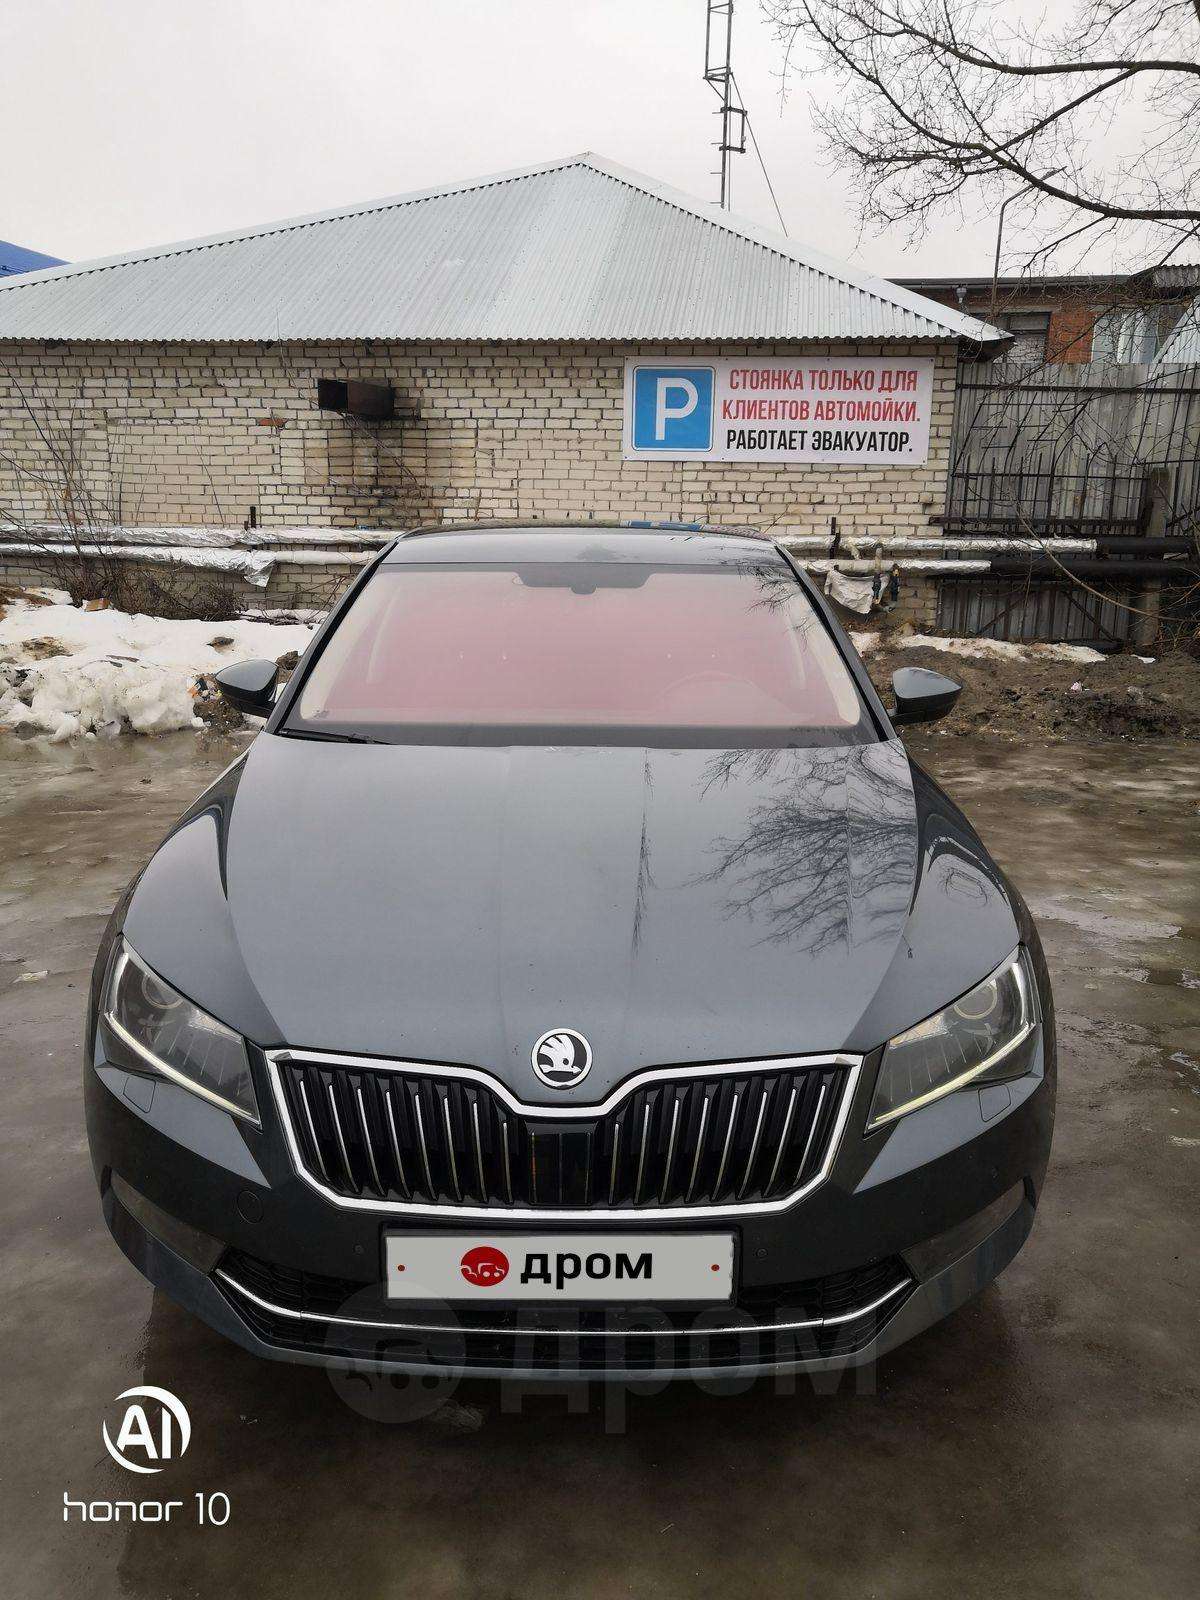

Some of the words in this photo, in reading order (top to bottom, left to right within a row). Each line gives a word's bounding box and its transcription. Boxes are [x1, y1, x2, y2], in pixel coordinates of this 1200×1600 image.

[729, 369, 804, 391] СТОЯНКА
[808, 369, 875, 392] ТОЛЬКО
[877, 370, 918, 393] ДЛЯ
[655, 378, 699, 441] P
[722, 399, 810, 421] КЛИЕНТОВ
[813, 398, 921, 422] АВТОМОЙКИ.
[726, 429, 808, 450] РАБОТАЕТ
[811, 431, 913, 452] ЭВАКУАТОР.
